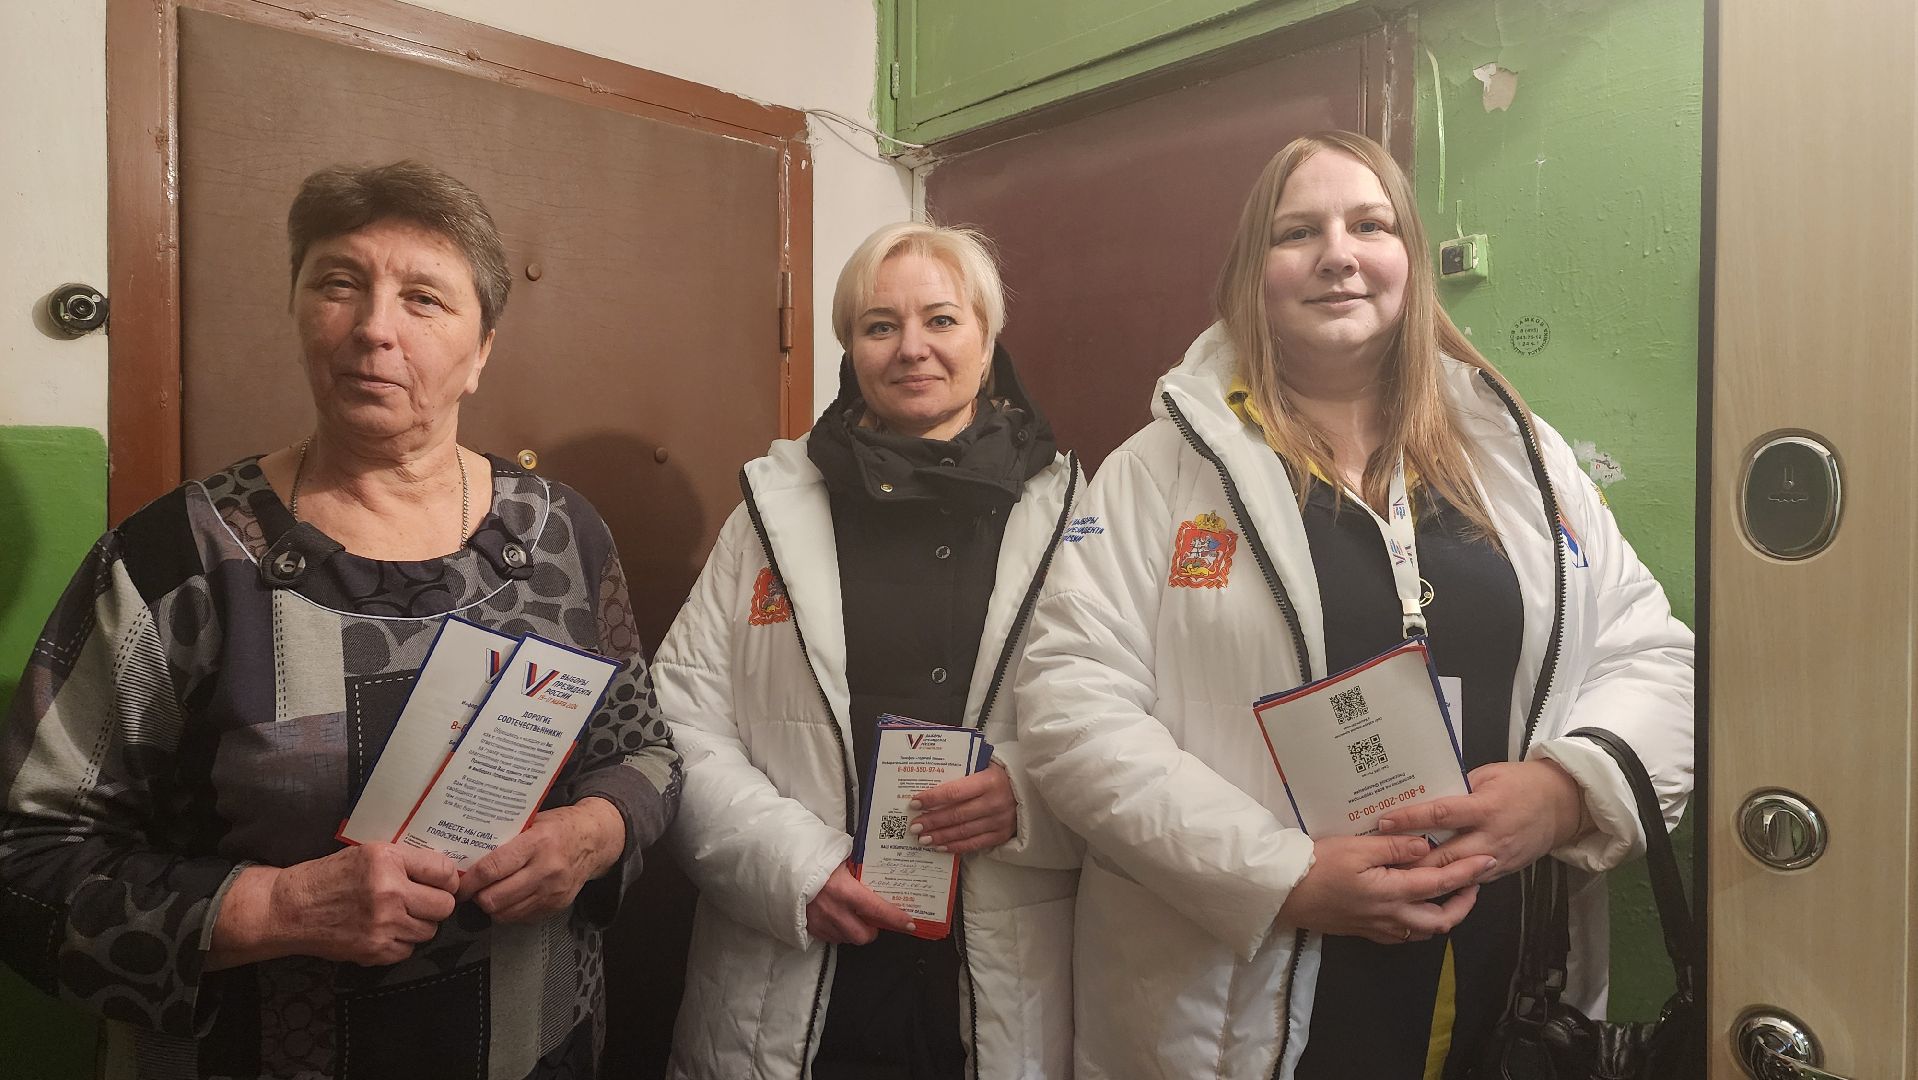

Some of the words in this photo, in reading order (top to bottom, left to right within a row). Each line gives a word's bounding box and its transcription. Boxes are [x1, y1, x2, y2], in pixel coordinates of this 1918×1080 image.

[1072, 517, 1099, 525] ЫБОРЫ
[560, 674, 589, 686] ВЫБОРЫ
[545, 688, 572, 700] РОССИИ
[552, 681, 592, 696] ПРЕЗИДЕНТА
[521, 711, 552, 724] ДОРОГИЕ
[498, 715, 563, 738] СООТЕЧЕСТВЕННИКИ!
[1348, 785, 1425, 821] 8-800-200-00-20
[426, 826, 461, 842] ГОЛОСУЕМ
[438, 820, 465, 832] ВМЕСТЕ
[477, 831, 493, 840] СИЛА
